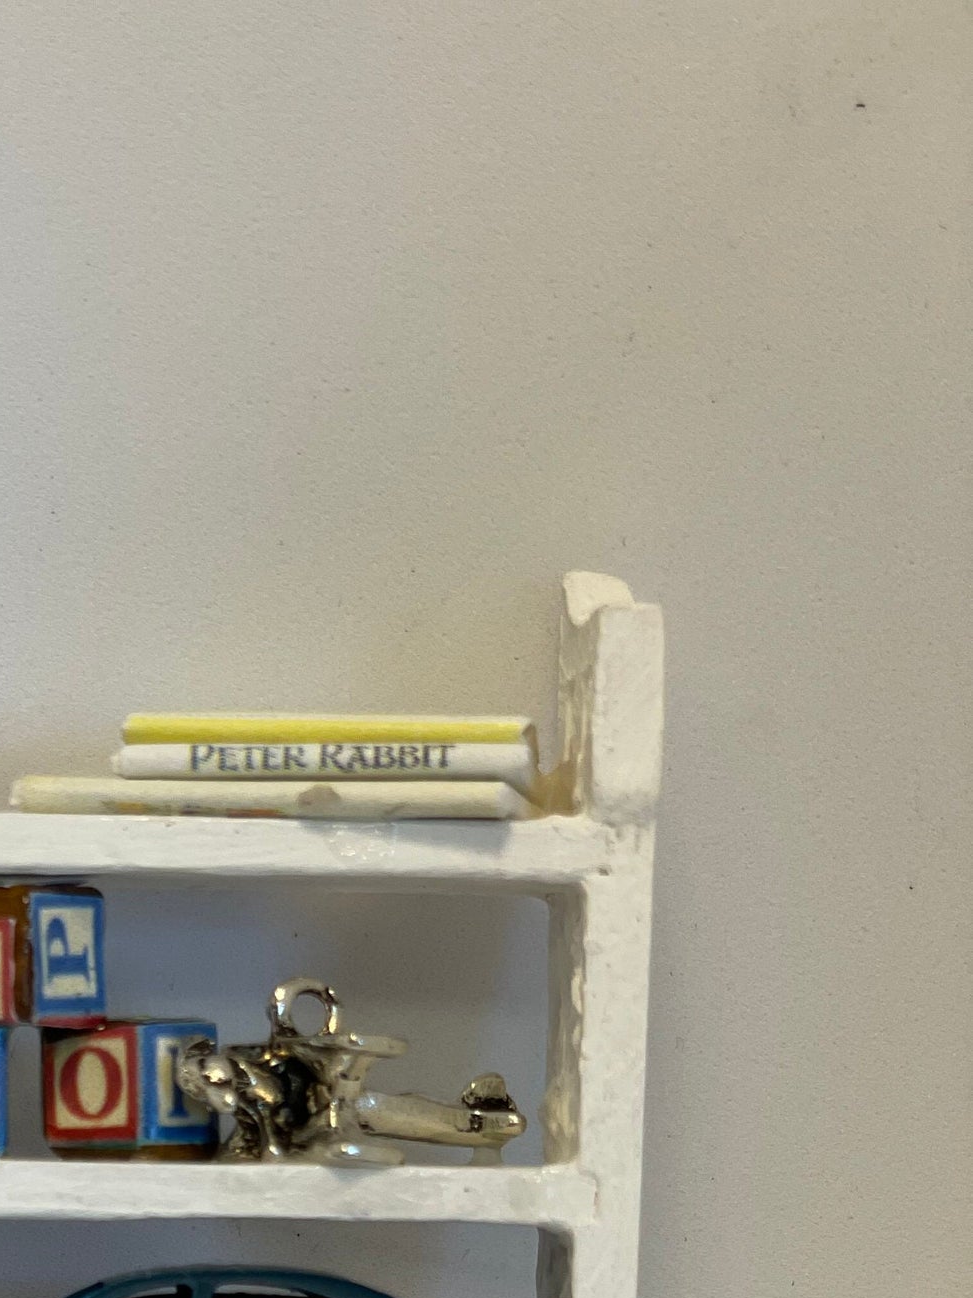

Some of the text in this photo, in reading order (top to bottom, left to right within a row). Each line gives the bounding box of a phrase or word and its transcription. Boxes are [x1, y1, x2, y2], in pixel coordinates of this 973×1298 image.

[190, 743, 457, 774] PETER RABBIT
[59, 1046, 123, 1121] O
